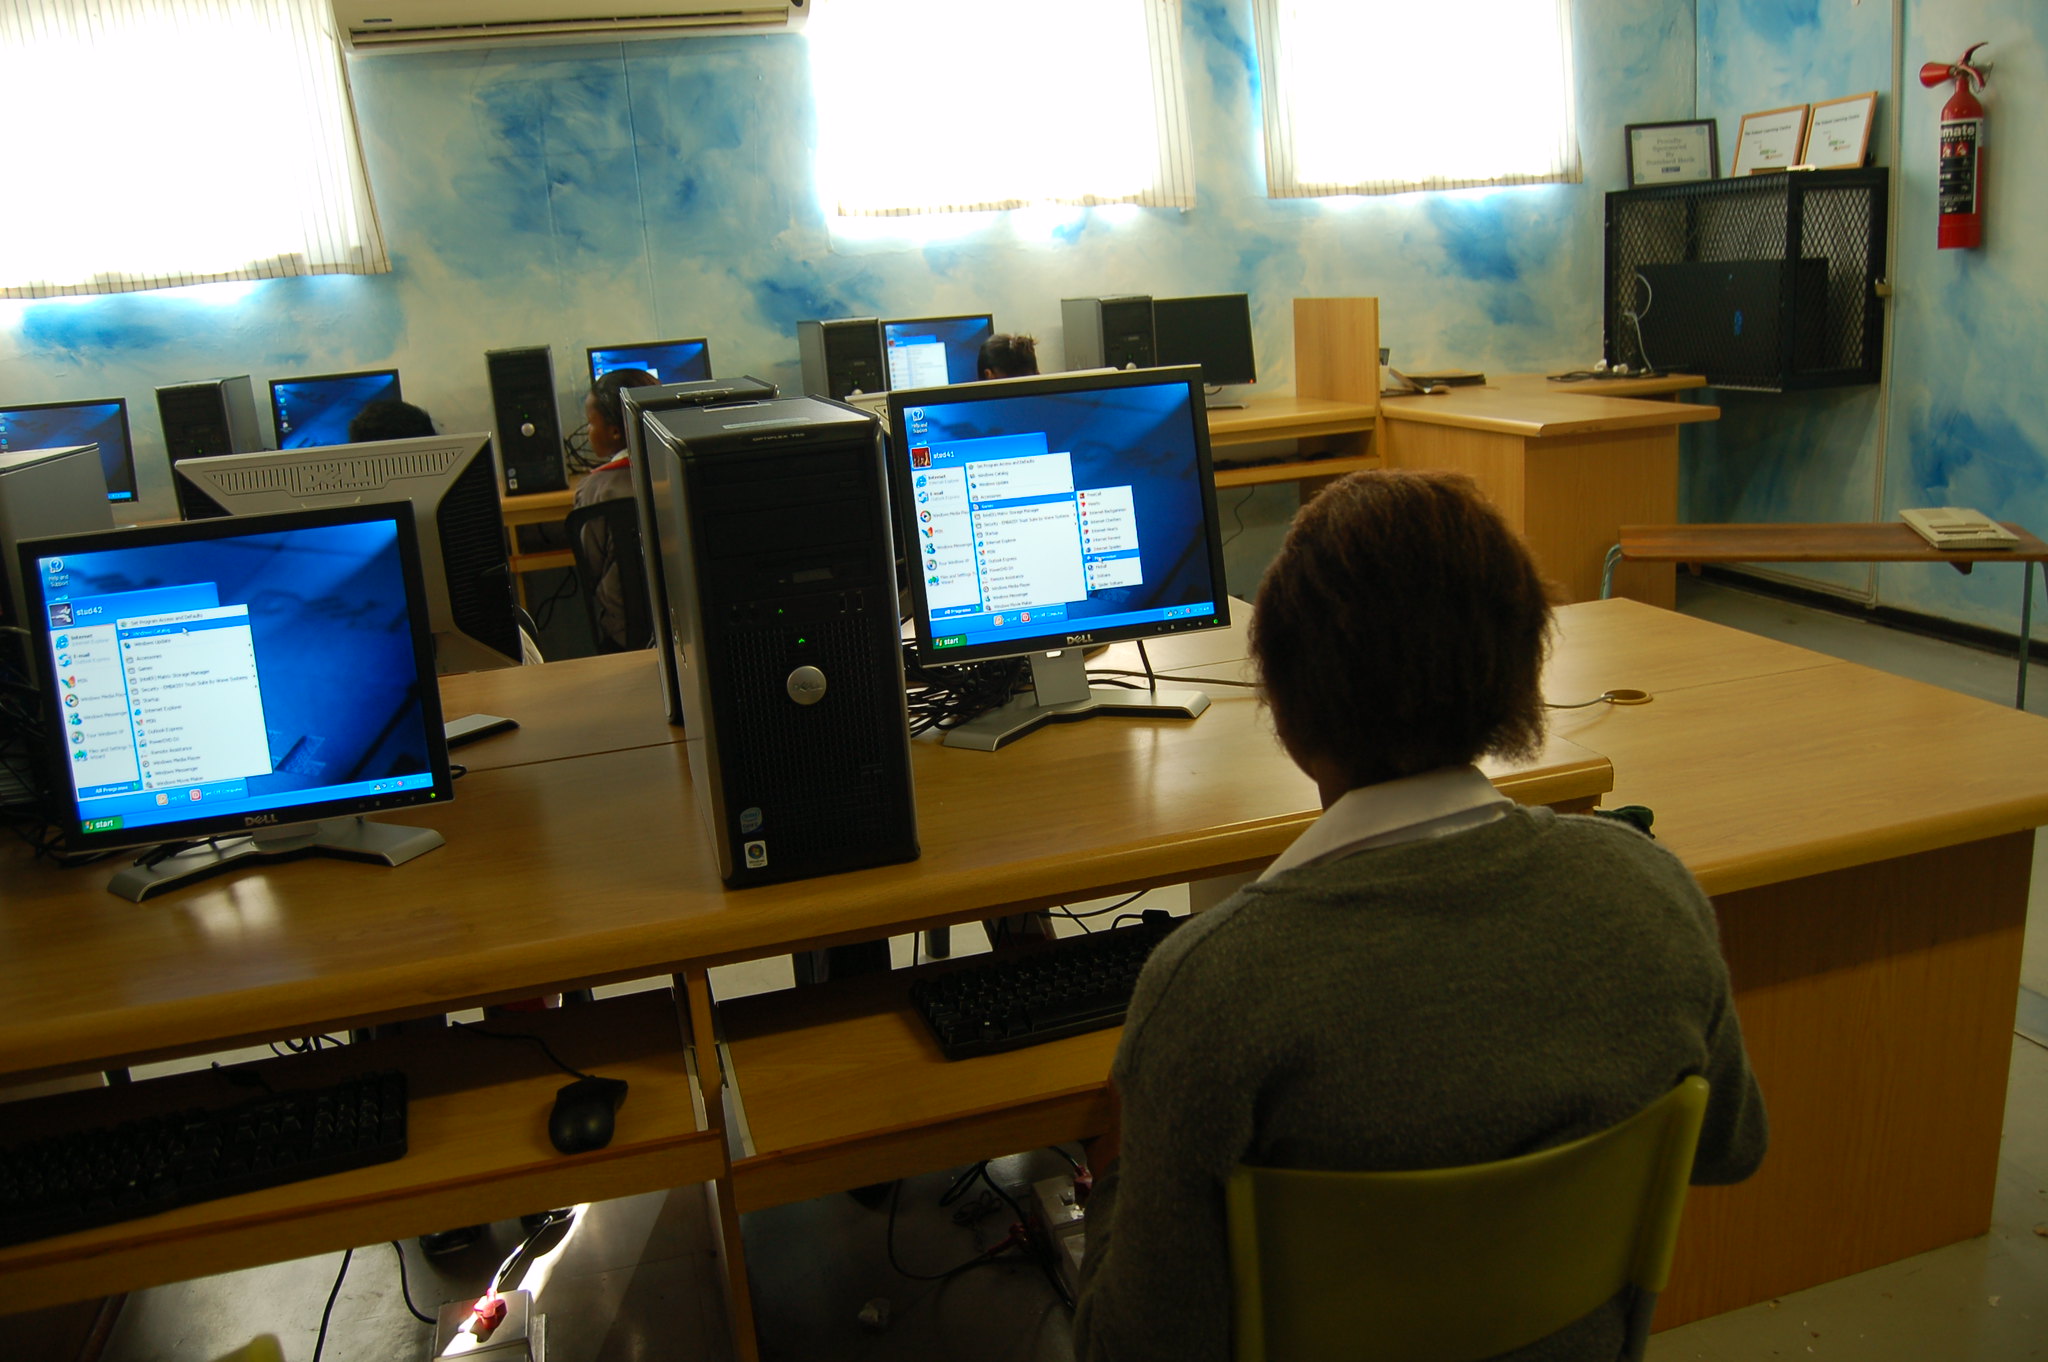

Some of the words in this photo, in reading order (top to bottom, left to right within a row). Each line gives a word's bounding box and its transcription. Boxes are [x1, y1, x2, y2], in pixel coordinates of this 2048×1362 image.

[75, 606, 103, 616] stud42
[943, 637, 959, 645] start
[1066, 633, 1094, 645] DELL
[94, 818, 114, 828] start
[244, 813, 278, 827] DELL
